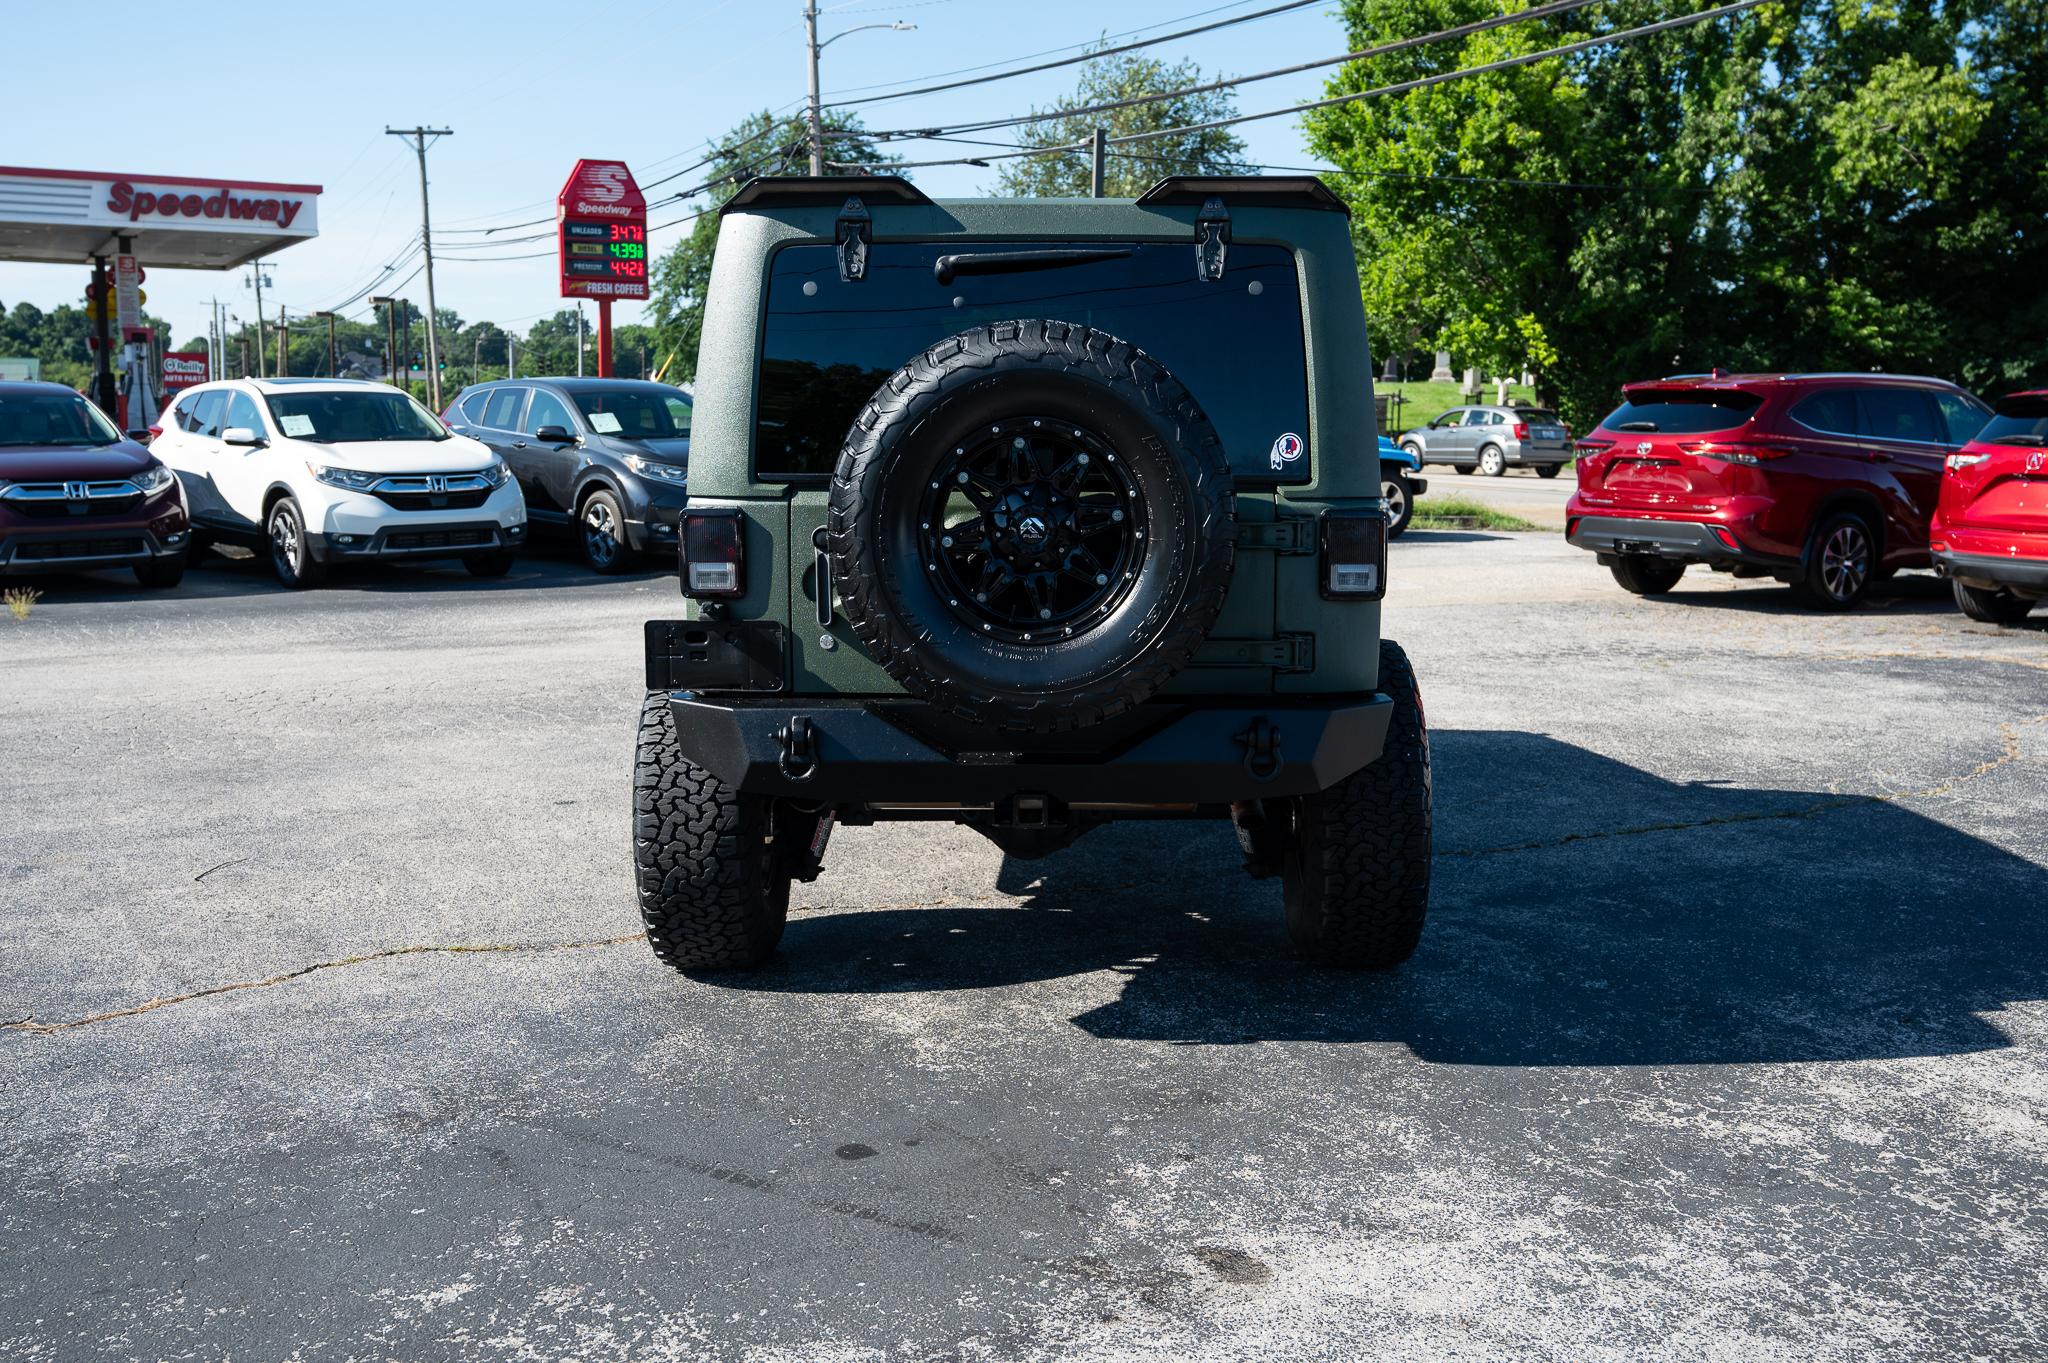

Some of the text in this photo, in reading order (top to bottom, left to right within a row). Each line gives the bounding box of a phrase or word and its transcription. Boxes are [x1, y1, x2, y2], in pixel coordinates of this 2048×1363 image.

[107, 181, 302, 228] Speedway
[577, 202, 632, 216] Speedway
[571, 226, 603, 235] UNLEADED
[587, 282, 613, 293] FRESH
[615, 283, 644, 295] COFFEE
[164, 358, 205, 373] O'Reilly
